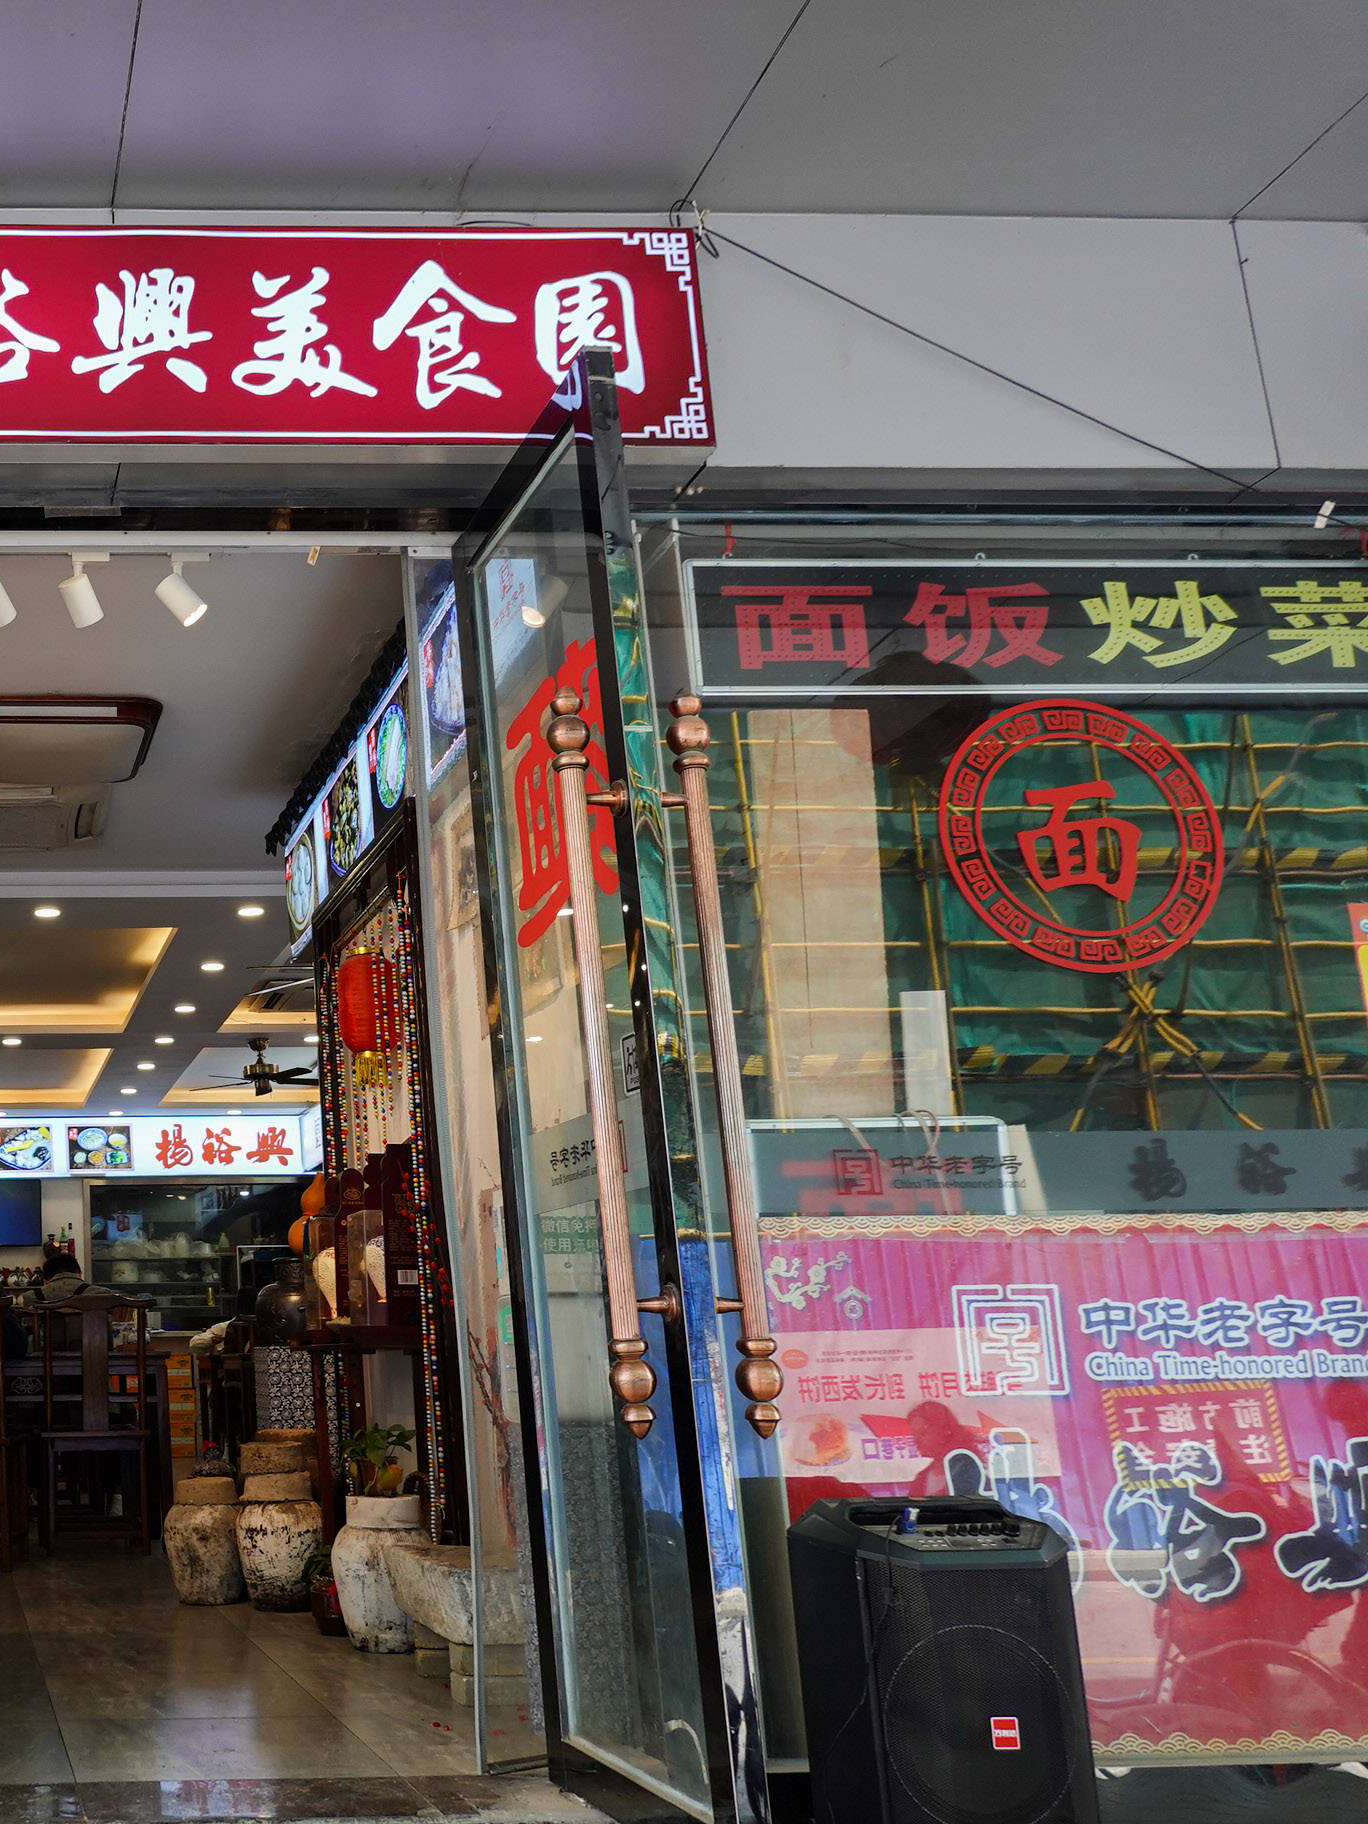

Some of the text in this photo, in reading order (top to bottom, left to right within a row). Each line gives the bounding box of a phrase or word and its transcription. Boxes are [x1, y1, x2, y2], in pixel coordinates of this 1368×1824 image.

[721, 580, 1368, 670] 面饭炒菜
[1017, 781, 1142, 902] 面
[155, 1124, 294, 1170] 楊裕興
[890, 1154, 1023, 1175] 中华老字号
[1079, 1295, 1368, 1349] 中华老字号
[1086, 1353, 1152, 1379] China
[1158, 1352, 1309, 1378] Time-honored
